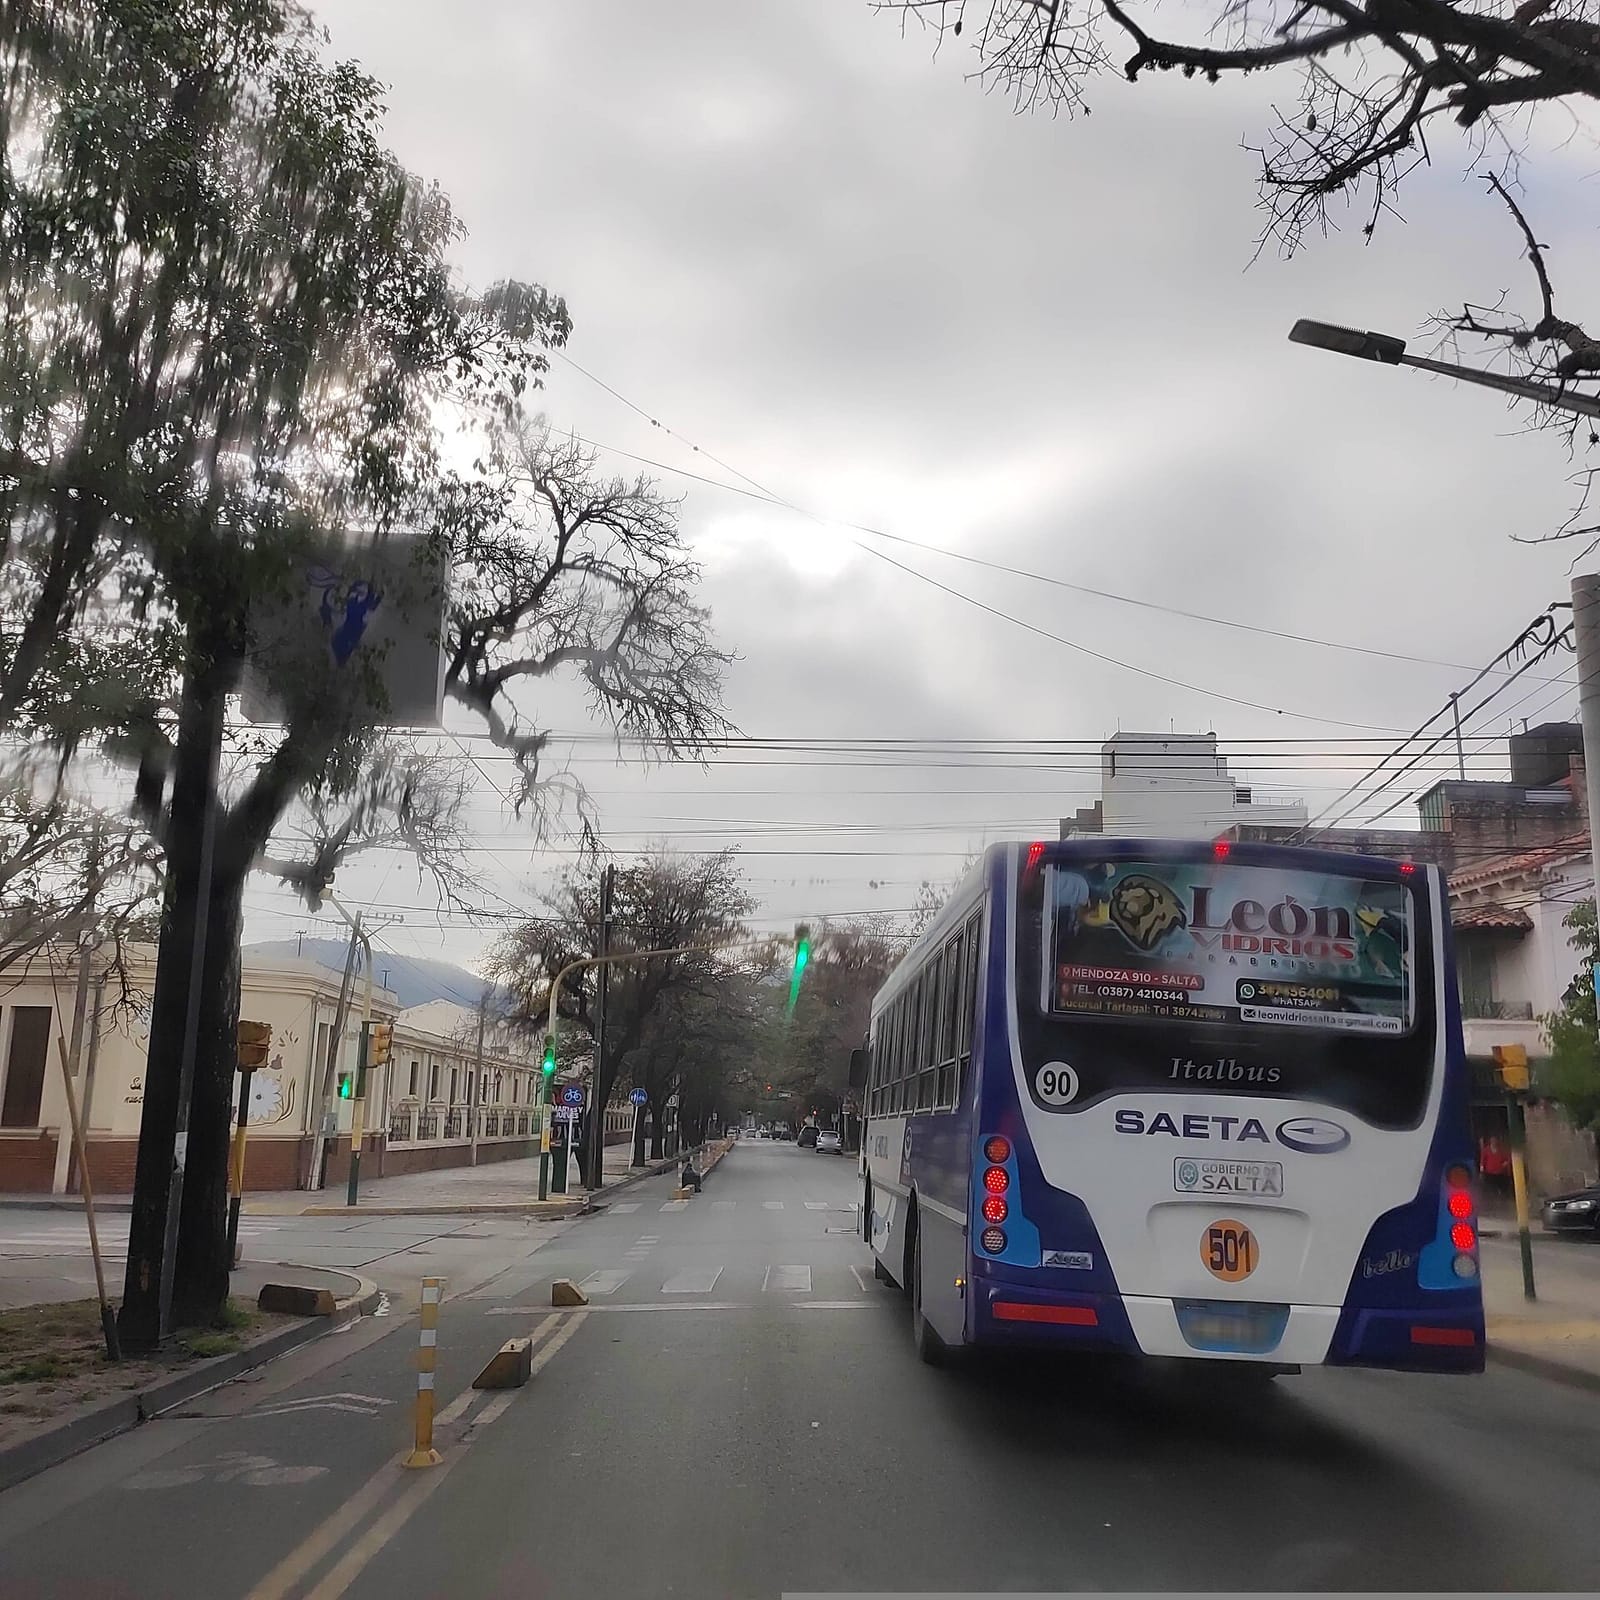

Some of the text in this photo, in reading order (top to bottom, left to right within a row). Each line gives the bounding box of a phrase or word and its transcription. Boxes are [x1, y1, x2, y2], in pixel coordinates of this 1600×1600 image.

[1187, 930, 1355, 961] VIDRIOS
[1071, 967, 1129, 982] MENDOZA
[1131, 972, 1151, 983] 910
[1160, 974, 1200, 987] SALTA
[1071, 983, 1184, 1001] TEL. (0387) 4210344
[1152, 1003, 1169, 1015] Tel
[1168, 1056, 1282, 1083] Italbus
[1042, 1069, 1071, 1097] 90
[1115, 1109, 1271, 1144] SAETA
[1201, 1163, 1260, 1177] GOBIERNO
[1201, 1174, 1278, 1194] SALTA
[1209, 1228, 1251, 1273] 501
